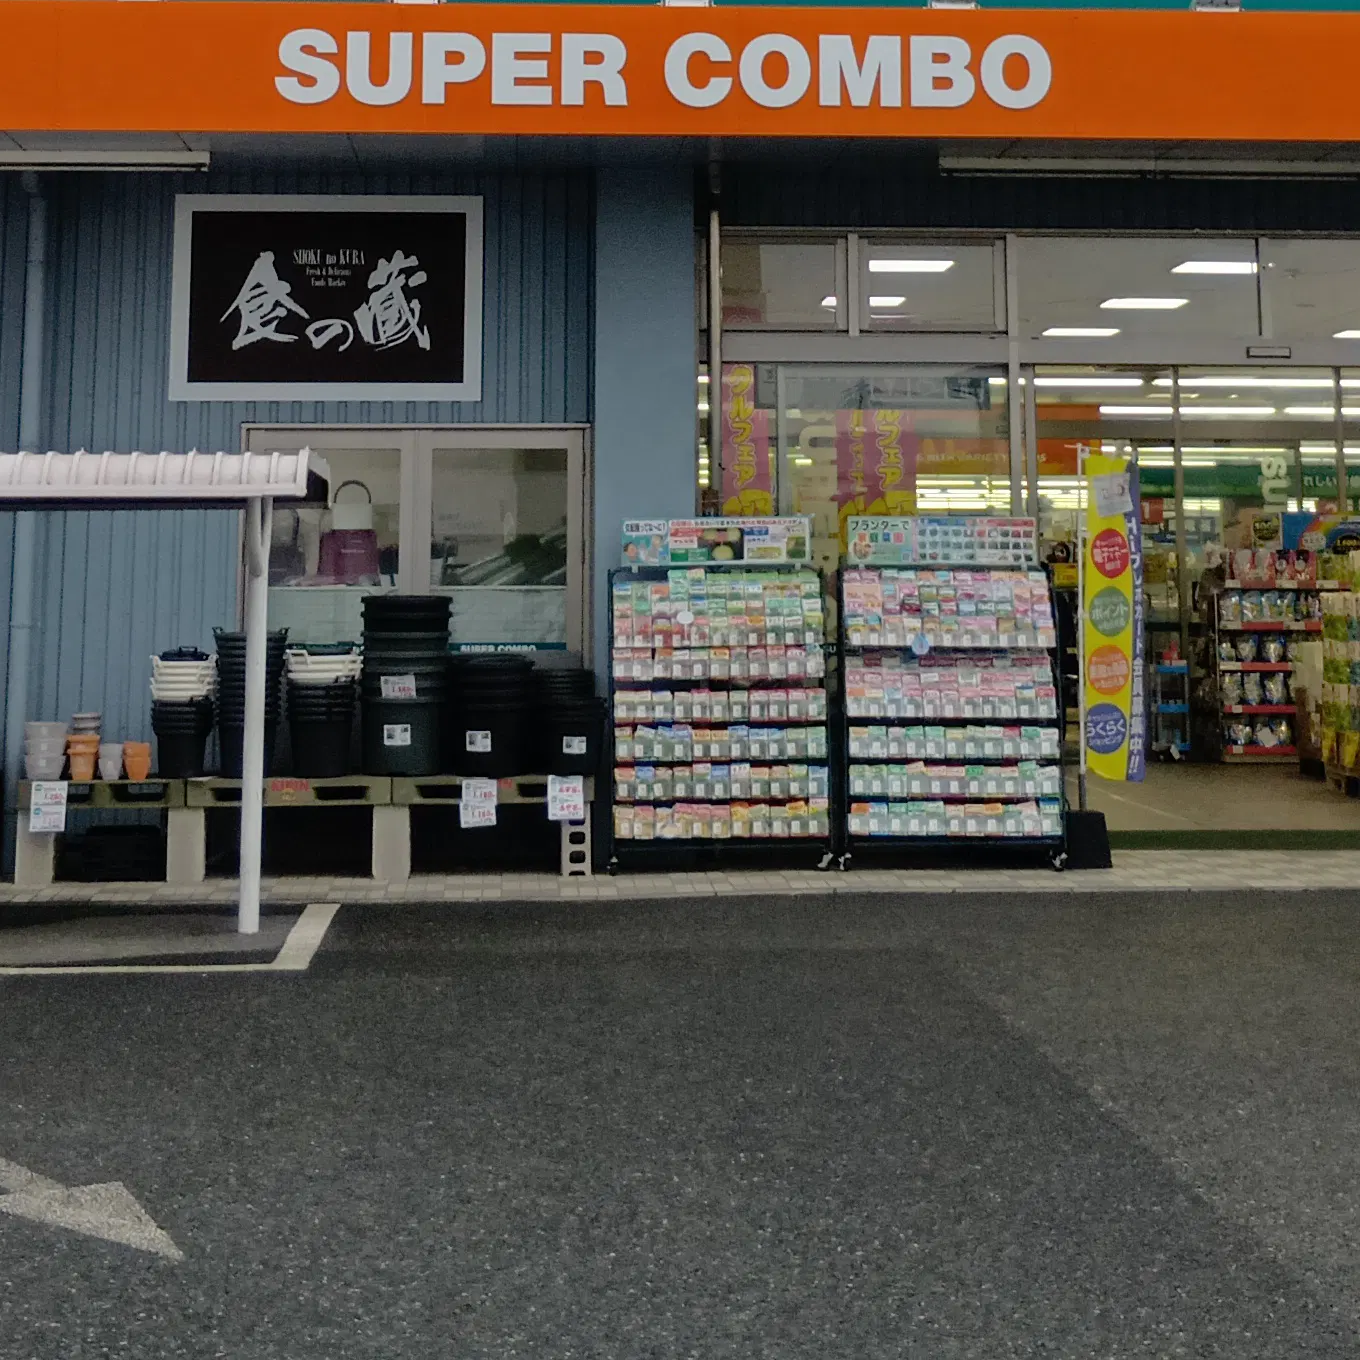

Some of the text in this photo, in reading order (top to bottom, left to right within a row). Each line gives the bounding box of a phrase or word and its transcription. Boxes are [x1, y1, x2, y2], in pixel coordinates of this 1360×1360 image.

[274, 28, 1052, 109] SUPER COMBO
[292, 248, 366, 265] SHOKU no KURA
[219, 249, 431, 351] 食の蔵
